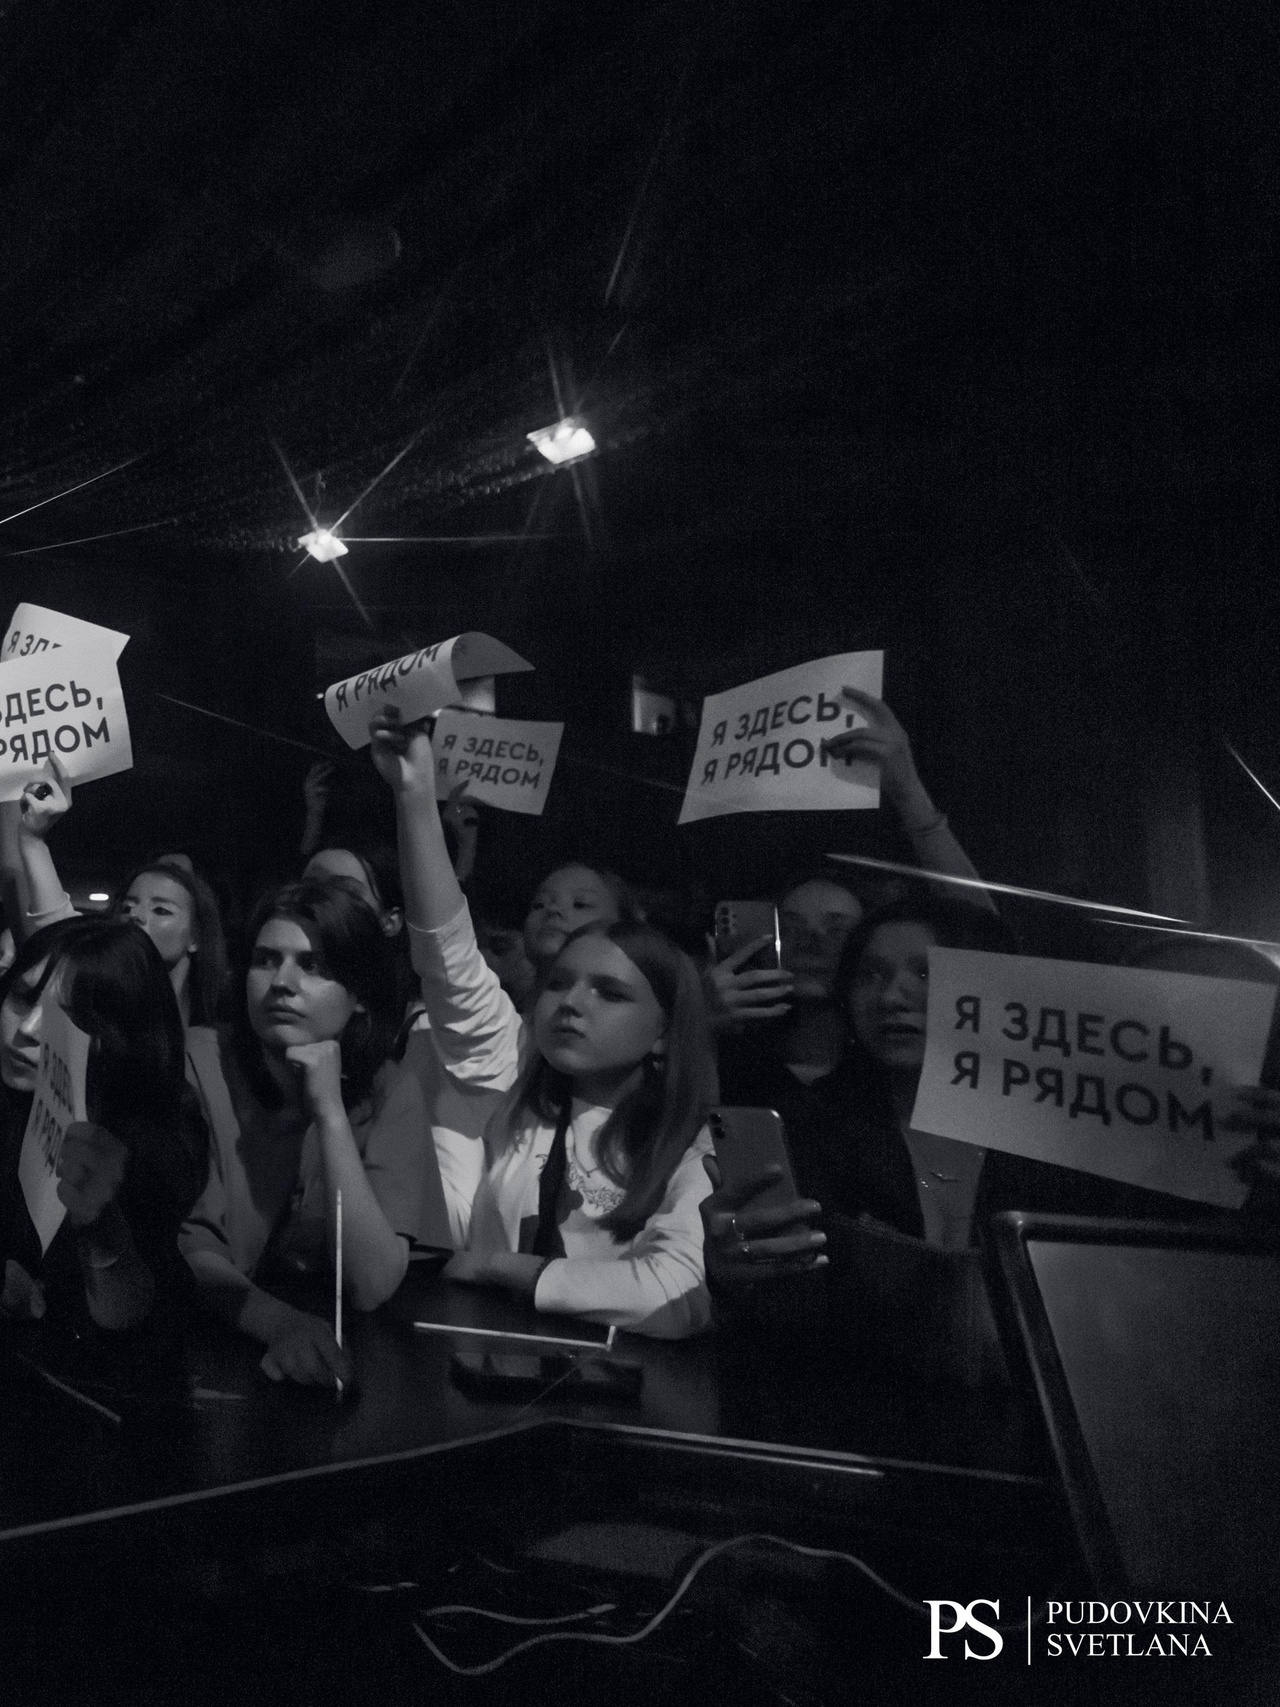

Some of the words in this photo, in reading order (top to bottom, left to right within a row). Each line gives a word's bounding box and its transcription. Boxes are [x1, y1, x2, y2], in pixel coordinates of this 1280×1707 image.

[335, 682, 349, 712] Я
[354, 642, 444, 701] РЯДОМ
[711, 720, 728, 748] Я
[734, 692, 854, 742] ЗДЕСЬ,
[442, 734, 457, 750] Я
[463, 736, 543, 767] ЗДЕСЬ,
[454, 759, 541, 789] РЯДОМ
[700, 758, 718, 786] Я
[954, 994, 981, 1034] Я
[1001, 1001, 1214, 1087] ЗДЕСЬ,
[949, 1050, 981, 1090] Я
[1002, 1057, 1216, 1143] РЯДОМ
